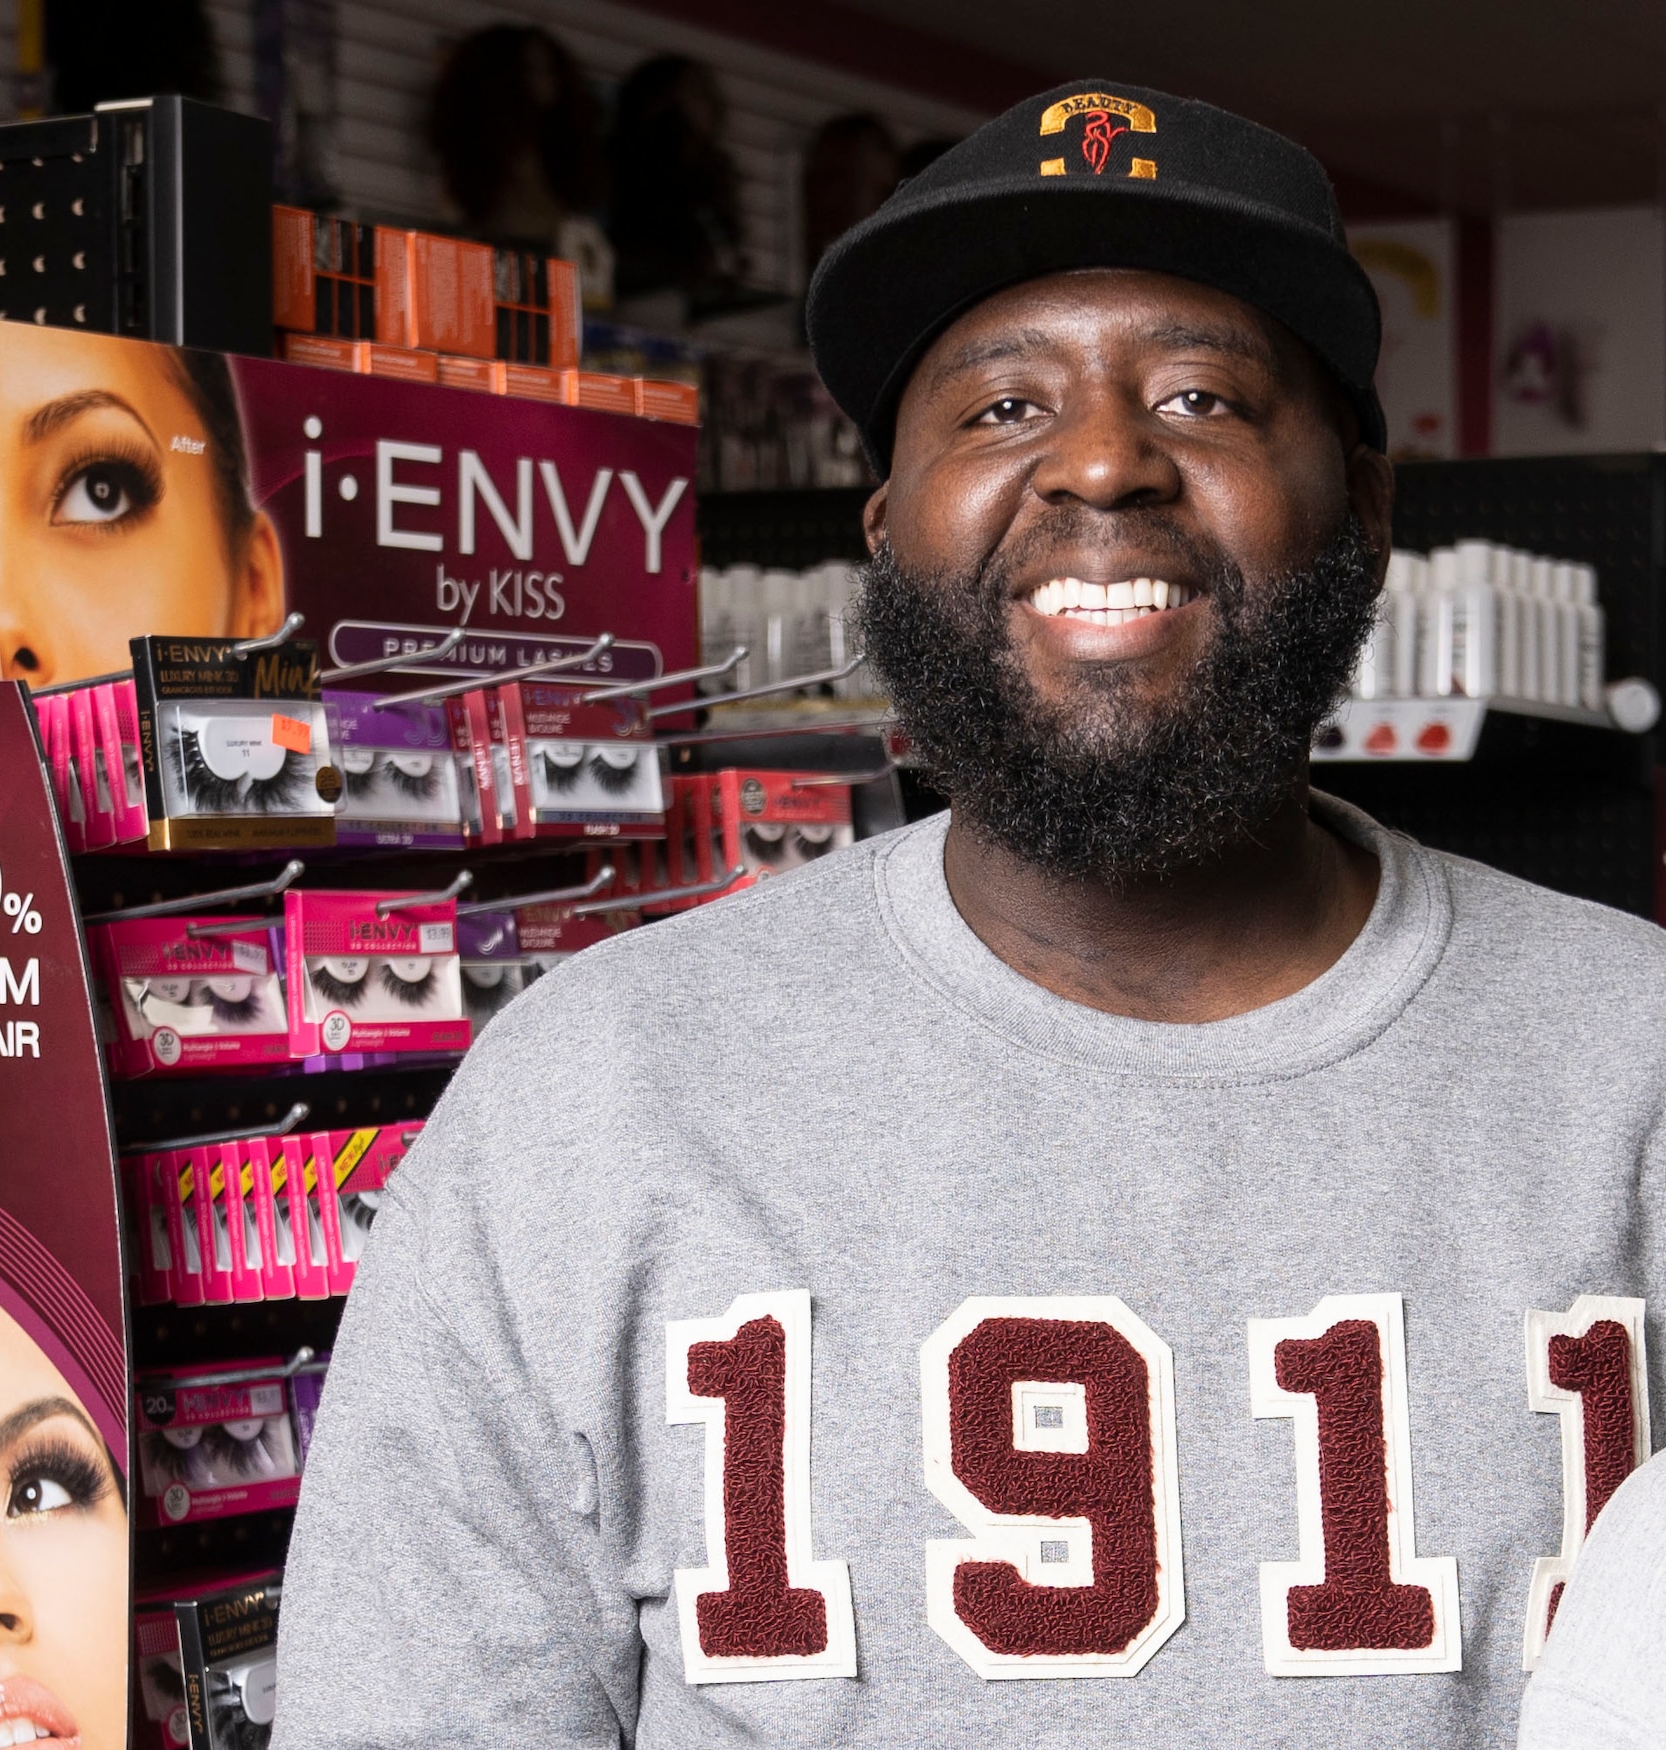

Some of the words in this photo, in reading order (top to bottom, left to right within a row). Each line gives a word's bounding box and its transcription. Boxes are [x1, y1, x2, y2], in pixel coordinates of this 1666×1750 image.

[1061, 97, 1139, 114] BEAUTY
[171, 435, 206, 456] After
[436, 569, 477, 626] by
[488, 570, 565, 620] KISS
[254, 652, 322, 699] Mink
[517, 647, 613, 673] LASES
[666, 1289, 1651, 1684] 1911
